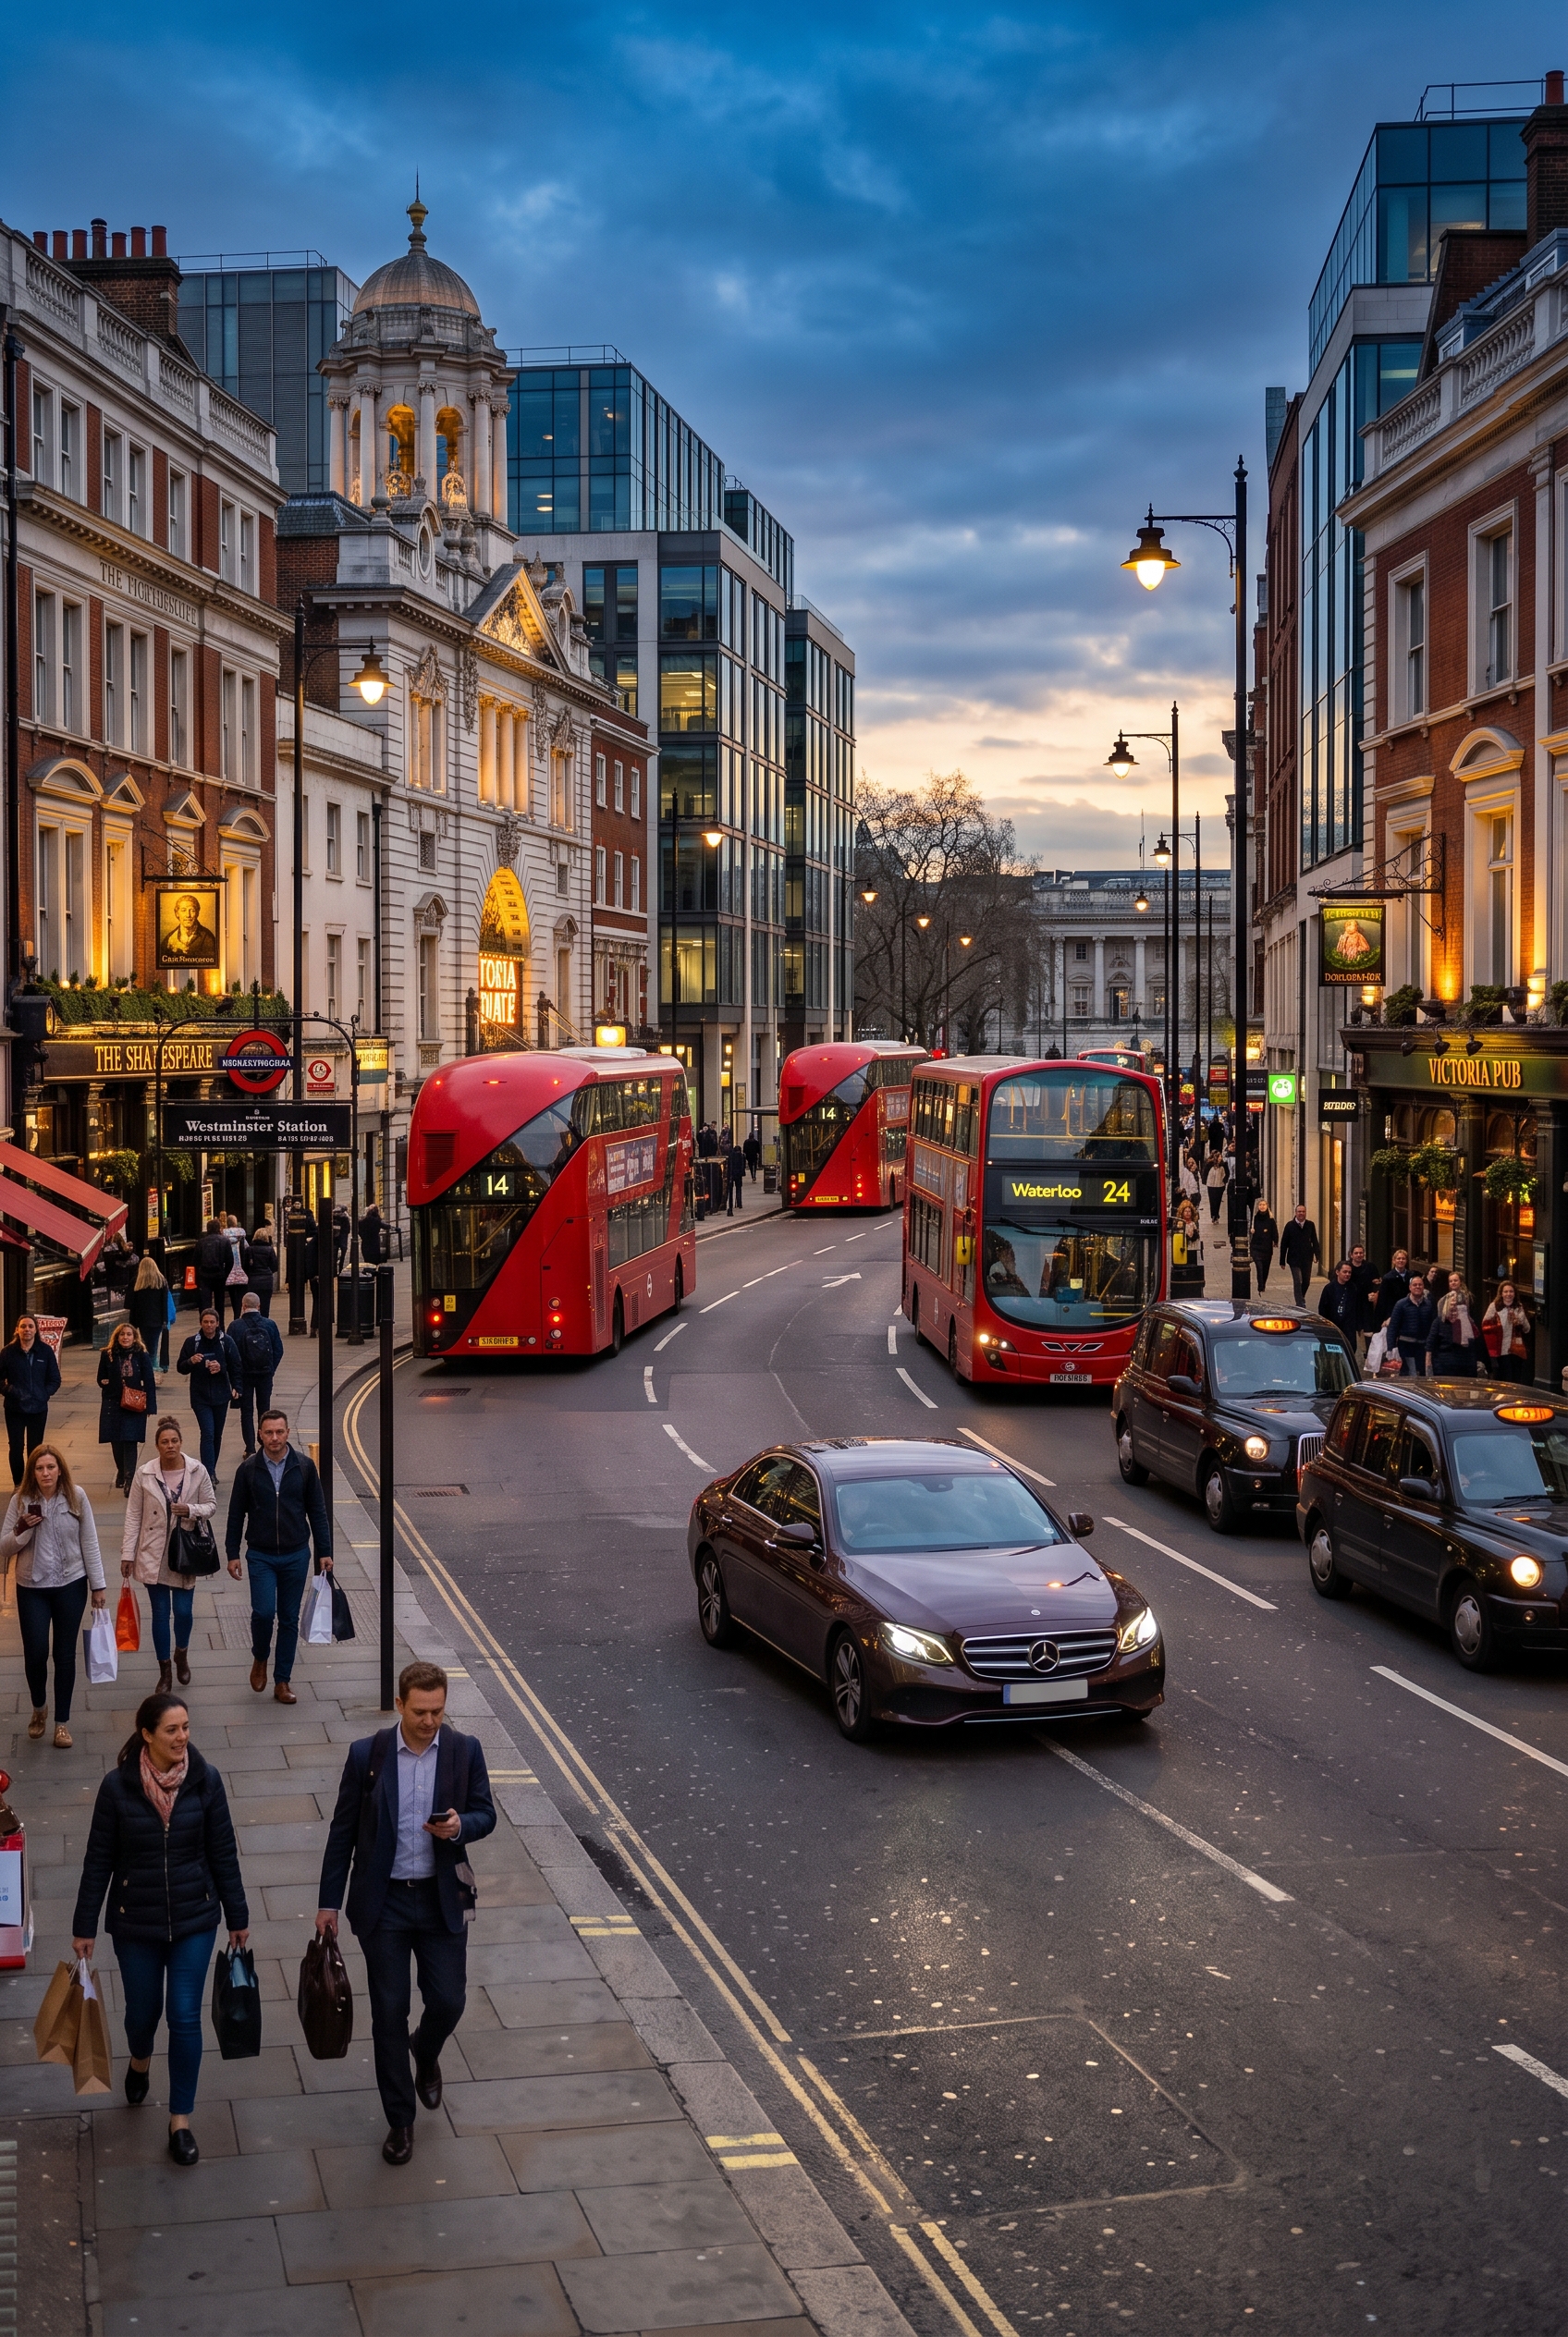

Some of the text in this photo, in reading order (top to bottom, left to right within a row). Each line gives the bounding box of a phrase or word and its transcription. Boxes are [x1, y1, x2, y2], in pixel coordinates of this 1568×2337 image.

[94, 1046, 122, 1071] THE
[1428, 1058, 1522, 1088] VICTORIA PUB
[822, 1107, 837, 1120] 14
[185, 1120, 328, 1132] Westminster Station
[486, 1174, 509, 1195] 14
[1011, 1181, 1131, 1203] Waterloo 24
